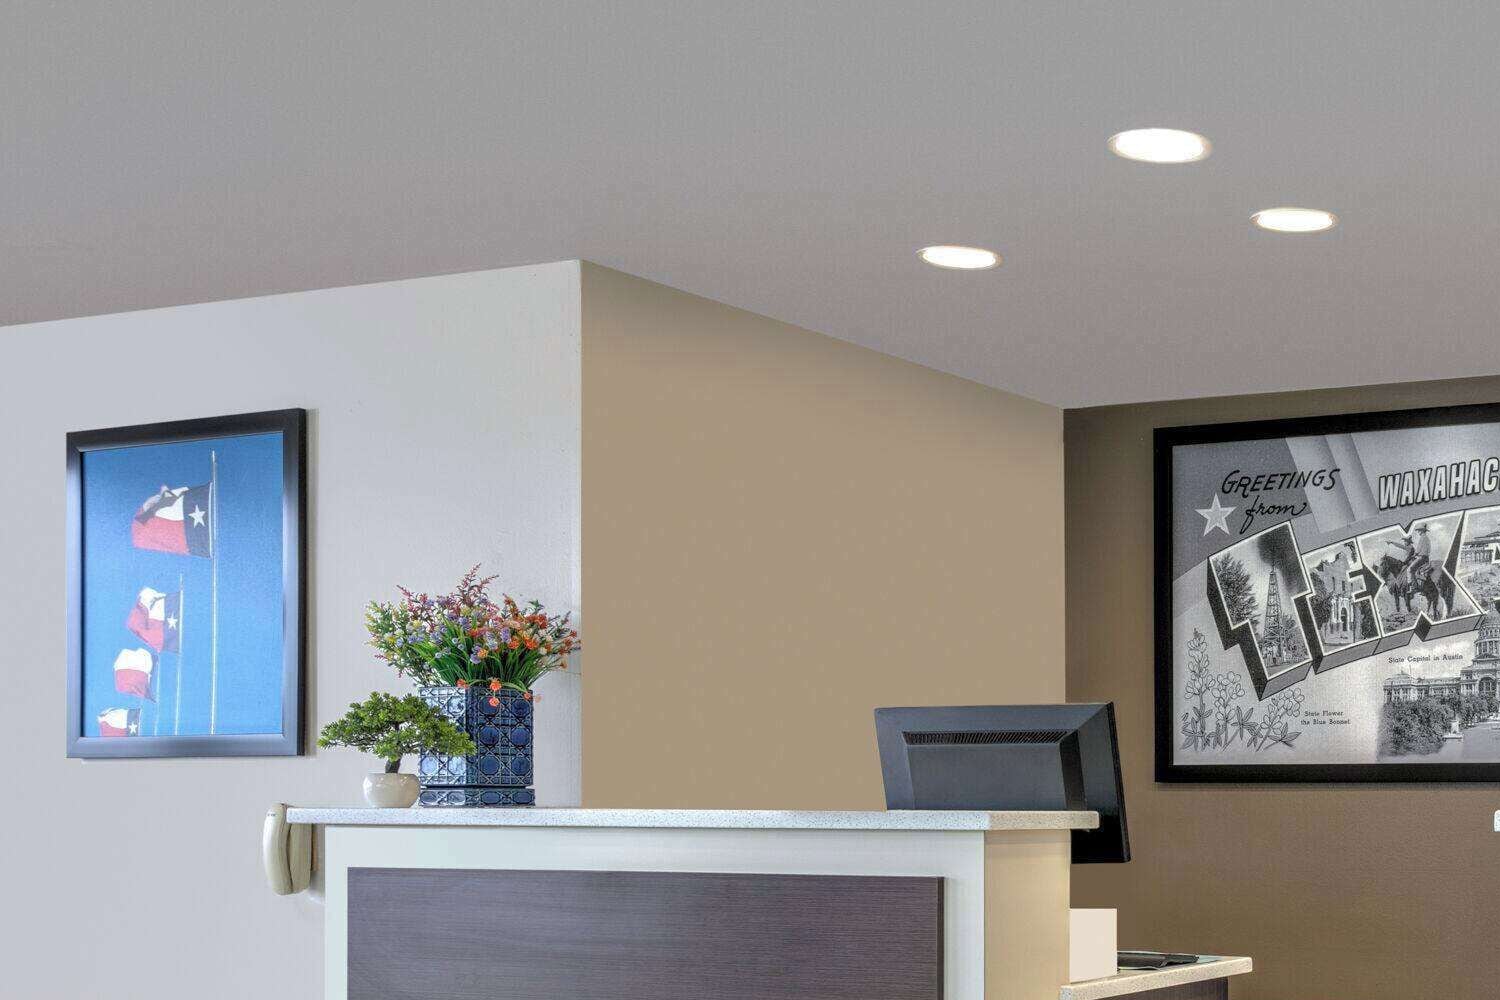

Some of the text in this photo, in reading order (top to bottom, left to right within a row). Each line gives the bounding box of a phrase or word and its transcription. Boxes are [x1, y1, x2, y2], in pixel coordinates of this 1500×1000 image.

[1221, 468, 1341, 498] GREETINGS
[1239, 495, 1308, 534] from
[1388, 656, 1405, 664] State
[1442, 653, 1464, 661] Austin
